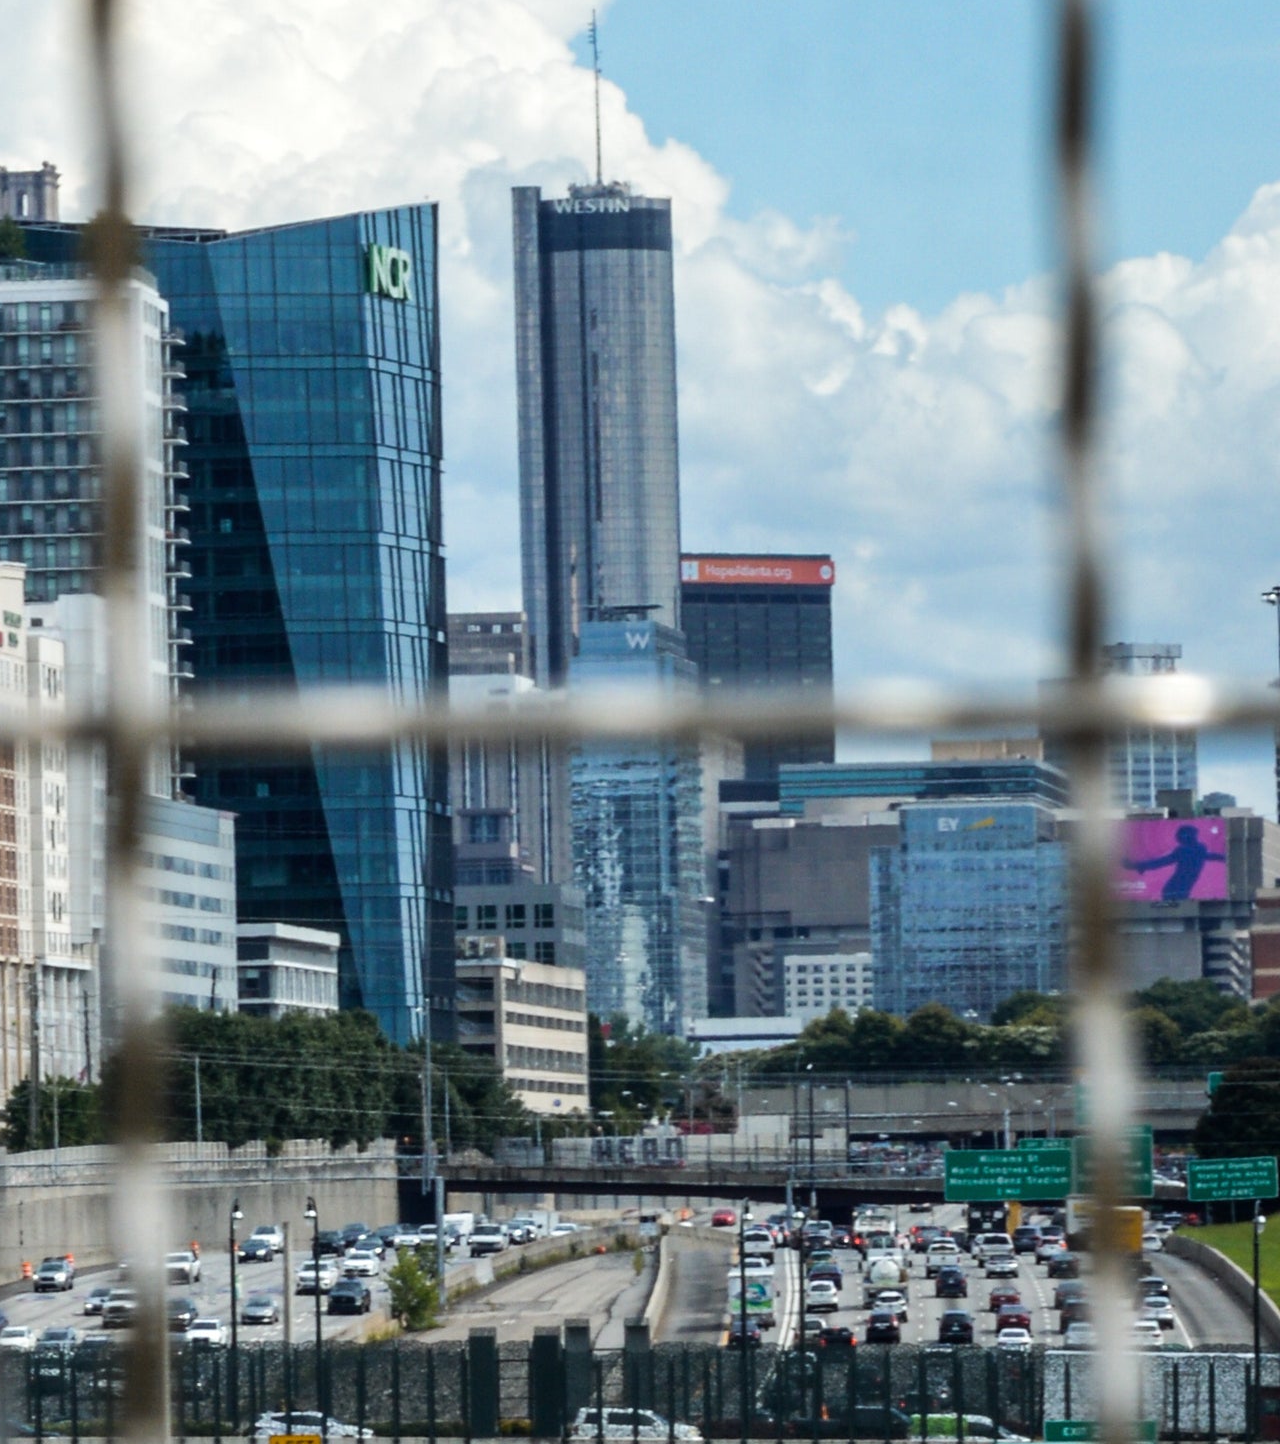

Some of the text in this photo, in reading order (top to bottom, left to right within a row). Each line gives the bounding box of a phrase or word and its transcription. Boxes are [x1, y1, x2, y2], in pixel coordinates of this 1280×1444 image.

[554, 197, 630, 215] WESTIN
[370, 243, 413, 301] NCR
[625, 631, 650, 649] W
[938, 817, 960, 832] EY
